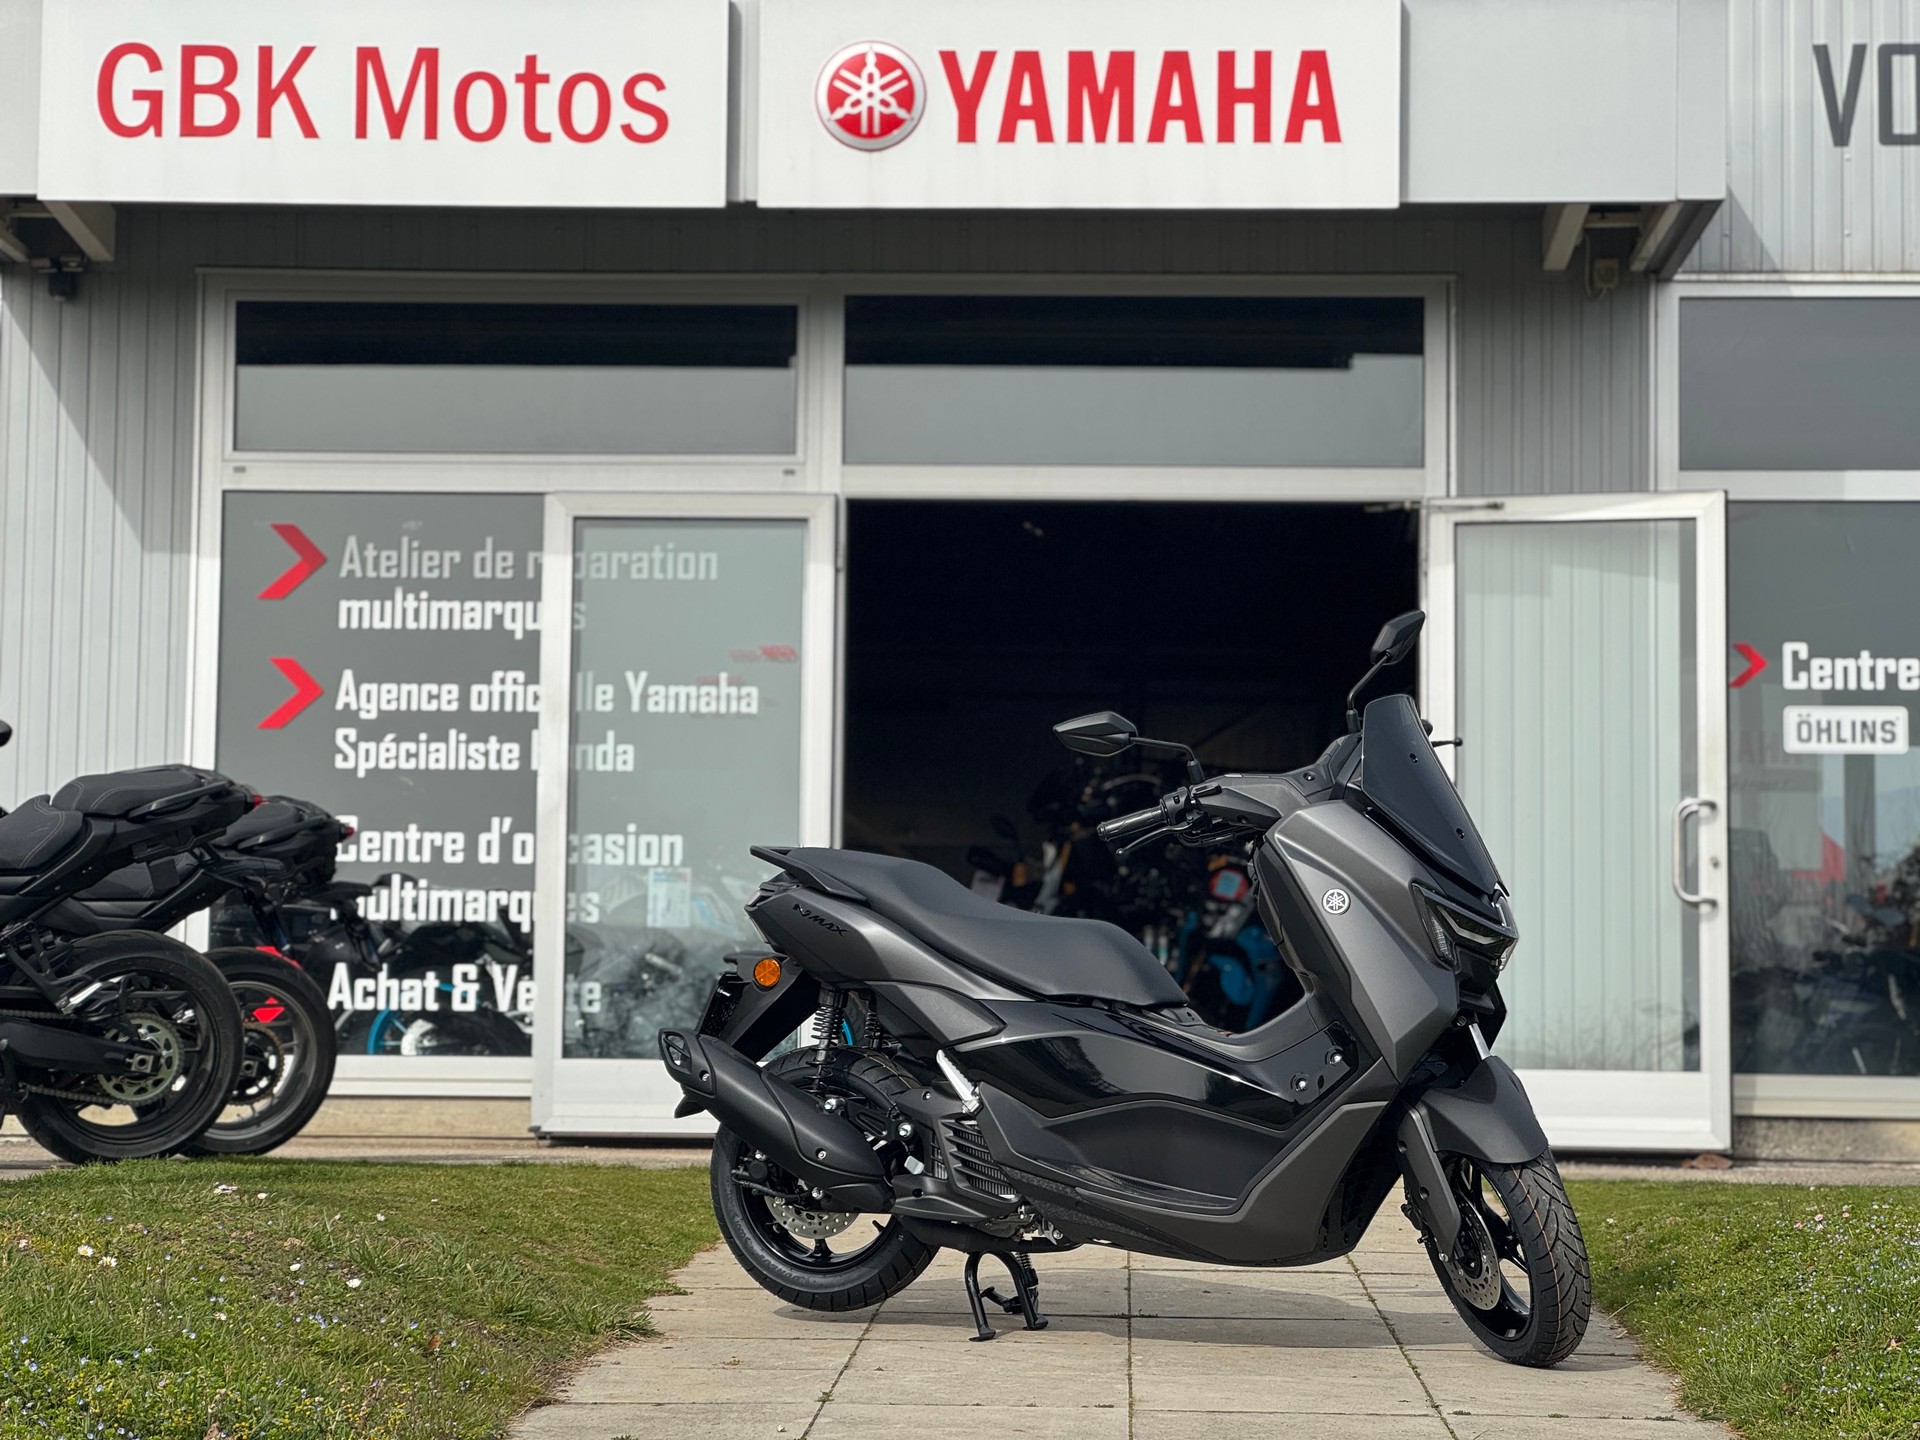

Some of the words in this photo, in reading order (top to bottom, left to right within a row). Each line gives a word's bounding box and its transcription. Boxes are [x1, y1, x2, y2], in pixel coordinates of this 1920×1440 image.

[97, 42, 320, 139] GBK
[354, 45, 671, 144] Motos
[938, 49, 1343, 144] YAMAHA
[338, 534, 462, 579] Atelier
[473, 535, 515, 580] de
[526, 541, 718, 581] raration
[338, 585, 587, 641] multimarqus
[1782, 641, 1920, 691] Centre
[335, 668, 460, 720] Agence
[469, 669, 614, 713] officlle
[624, 670, 759, 715] Yamaha
[334, 727, 521, 779] Spécialiste
[530, 728, 635, 772] nda
[1796, 713, 1898, 744] ÖHLINS
[477, 816, 684, 867] d'ocasion
[330, 873, 600, 934] ultimarqs
[327, 962, 440, 1012] Achat
[452, 963, 480, 1012] &
[491, 964, 602, 1014] Vete
